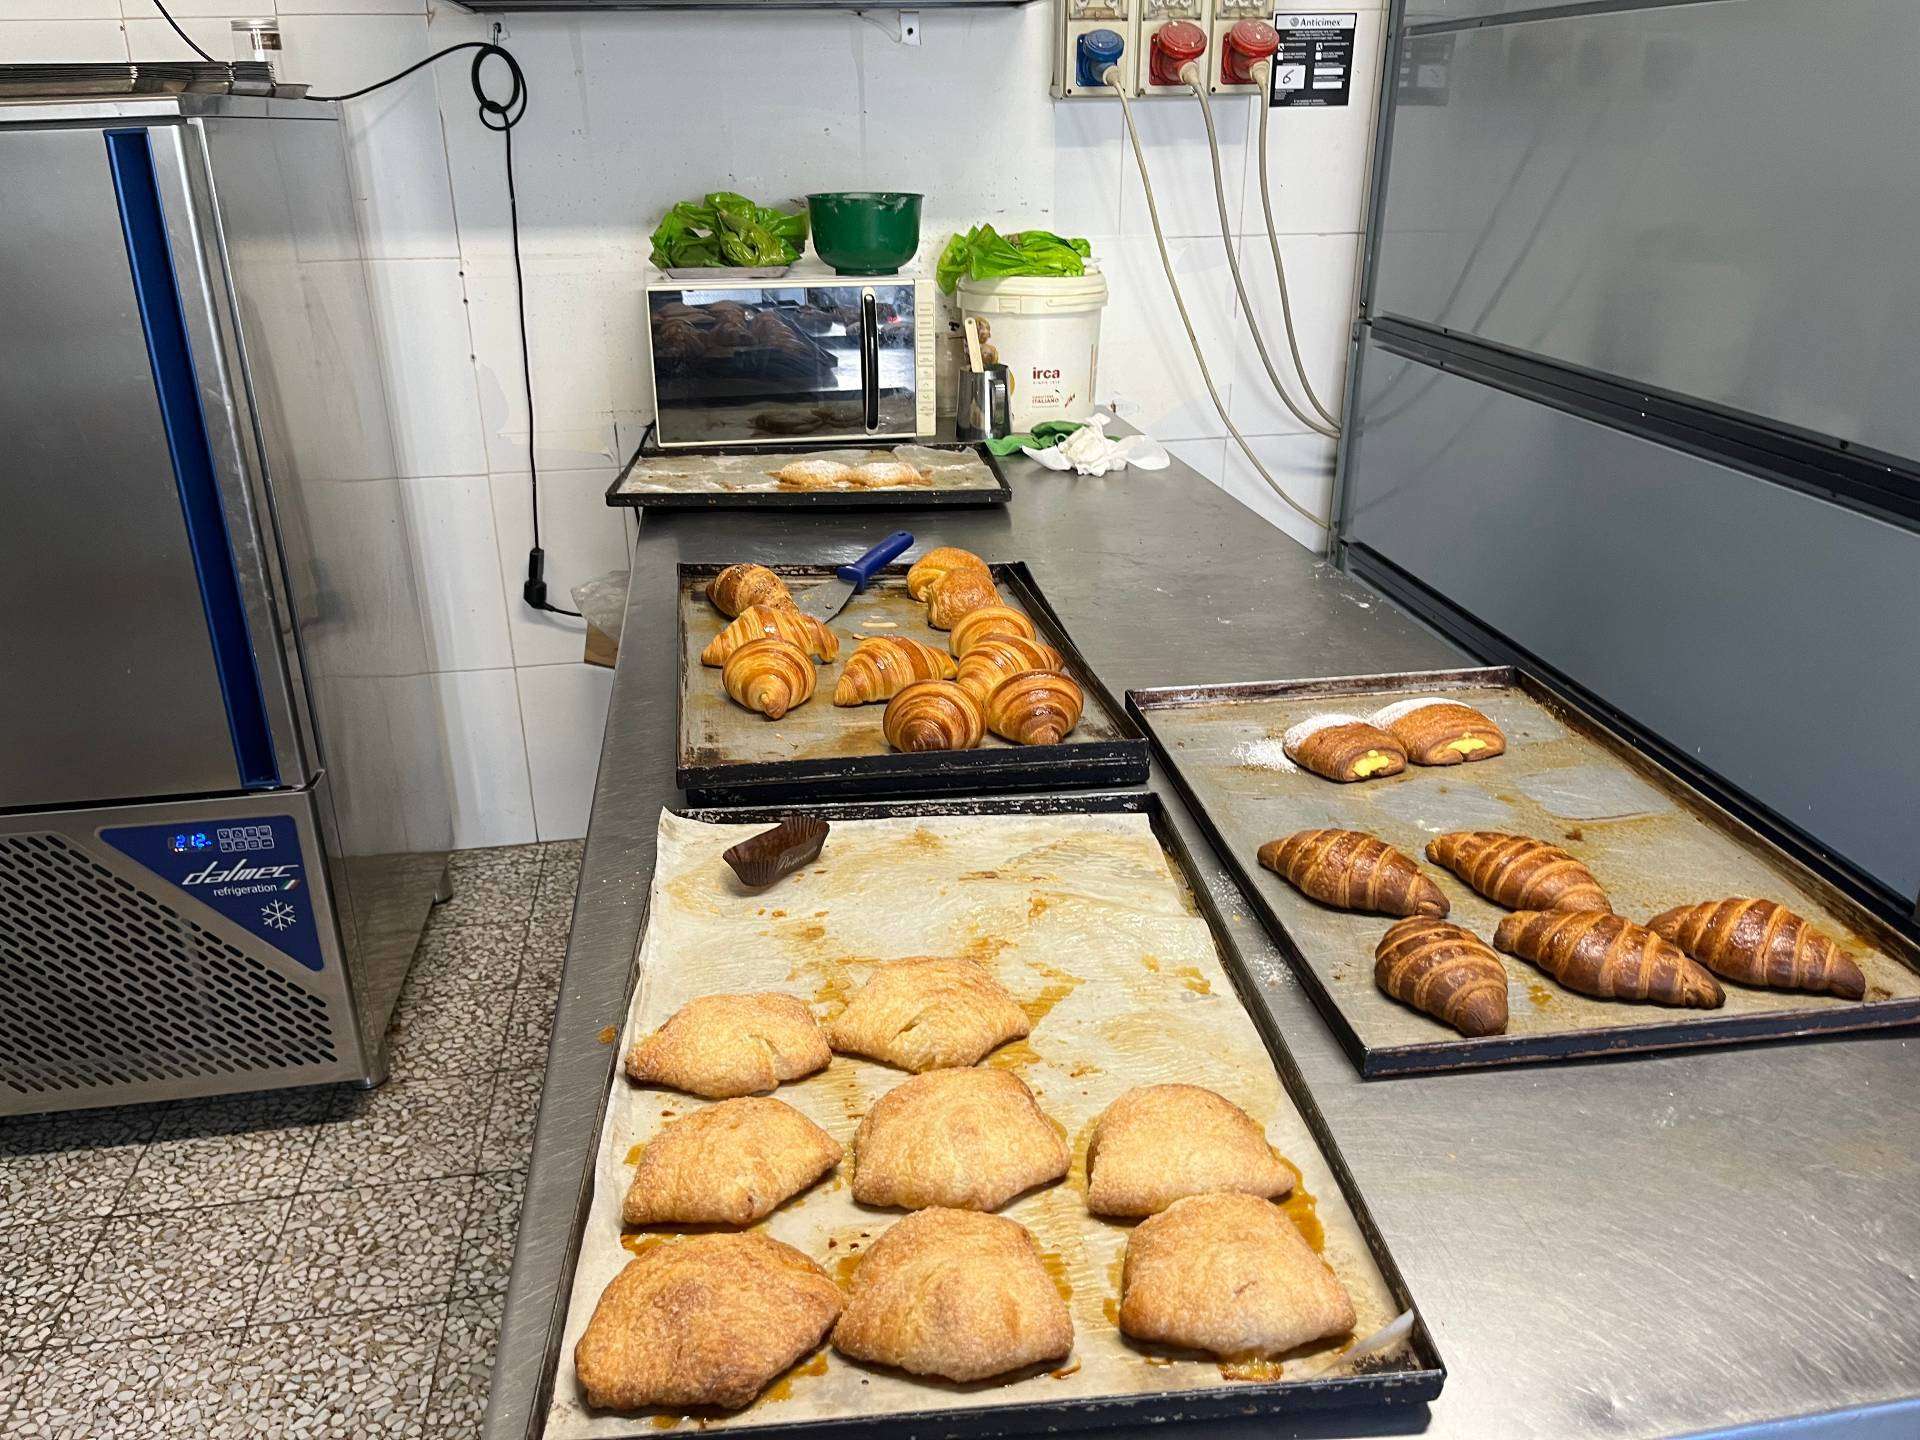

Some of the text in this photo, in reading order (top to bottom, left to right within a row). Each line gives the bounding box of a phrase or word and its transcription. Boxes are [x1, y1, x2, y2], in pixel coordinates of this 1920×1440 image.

[1300, 17, 1341, 27] Anticimex
[1282, 69, 1295, 84] 6
[1032, 367, 1060, 380] irca
[181, 858, 299, 885] dalmec
[213, 884, 278, 897] refrigeration
